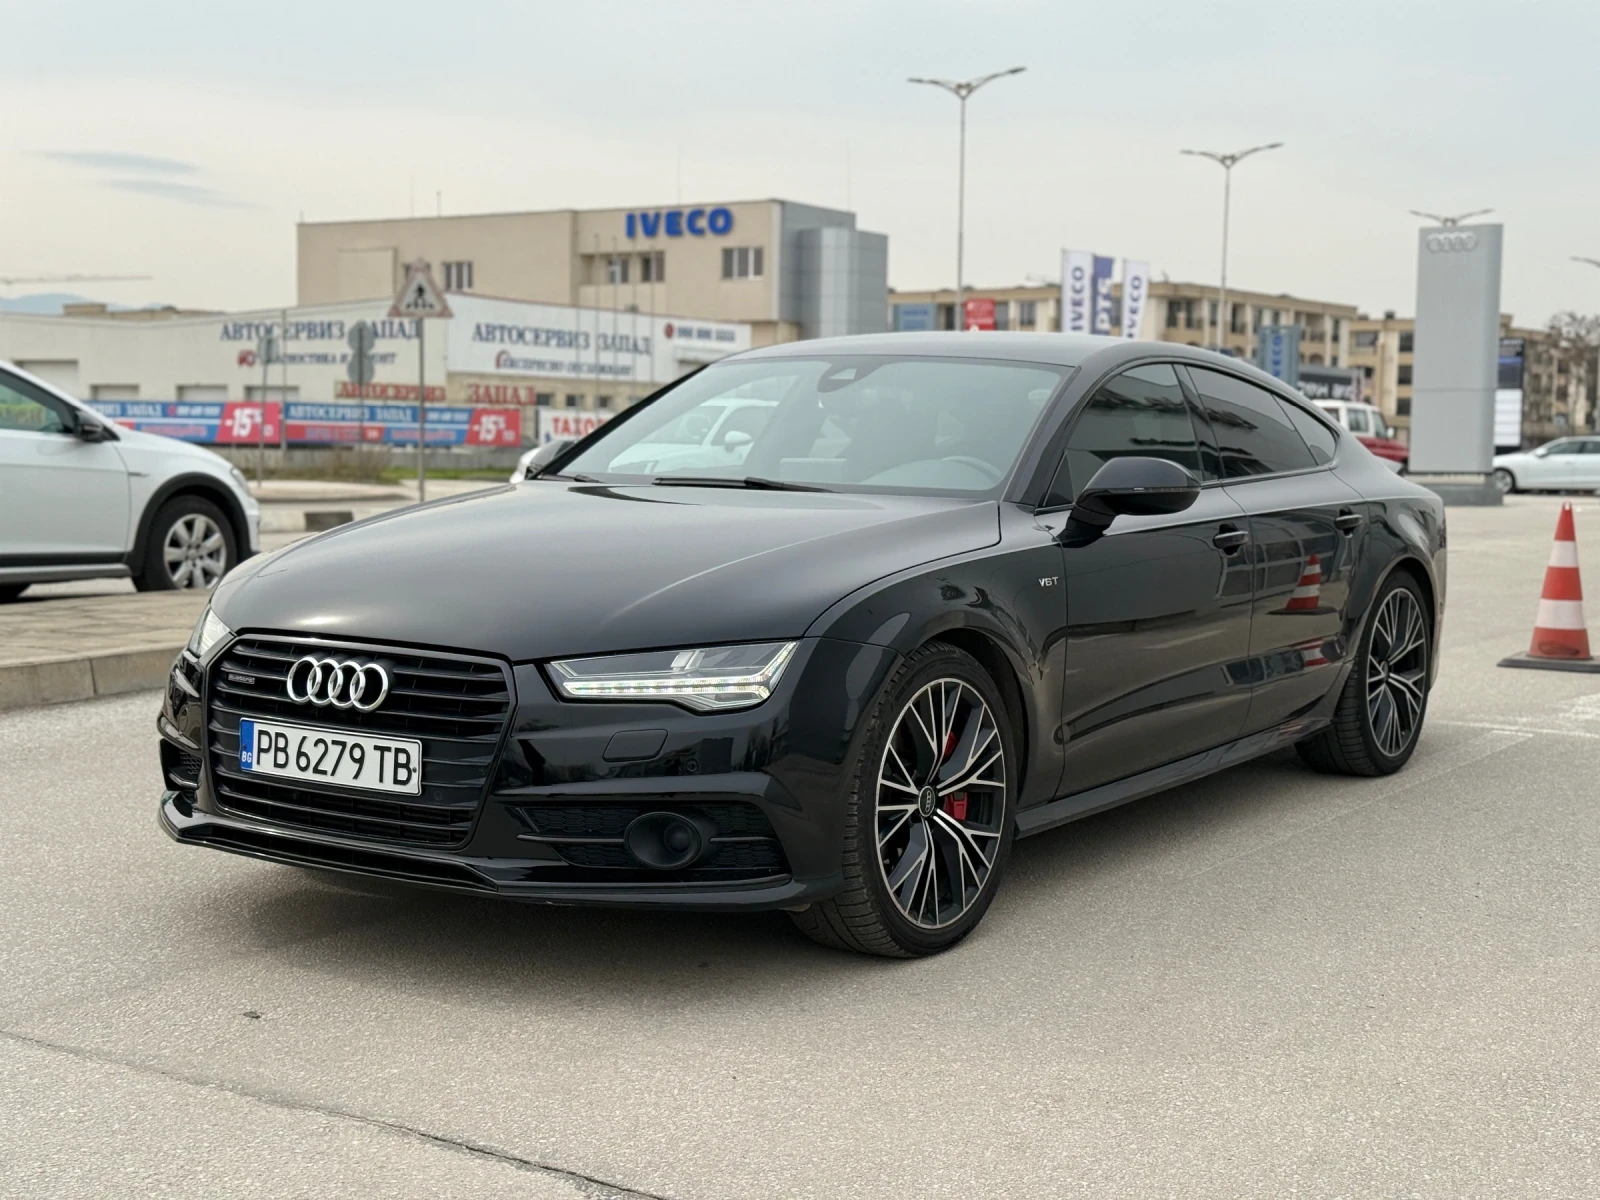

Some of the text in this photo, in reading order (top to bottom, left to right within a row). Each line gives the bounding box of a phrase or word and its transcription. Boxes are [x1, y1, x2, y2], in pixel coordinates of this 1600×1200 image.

[625, 207, 733, 239] IVECO
[1071, 266, 1084, 331] IVECO
[1127, 275, 1141, 338] IVECO
[220, 319, 345, 342] АВТОСЕРВИЗ
[472, 322, 590, 350] АВТОСЕРВИЗ
[598, 332, 652, 356] ЗАПАД
[466, 383, 536, 406] ЗАПАД
[288, 403, 370, 421] АВТОСЕРВИЗ
[375, 407, 413, 422] ЗАПАД
[552, 416, 606, 436] ТАХО
[241, 751, 252, 763] BG
[256, 729, 412, 786] PB 6279 TB
